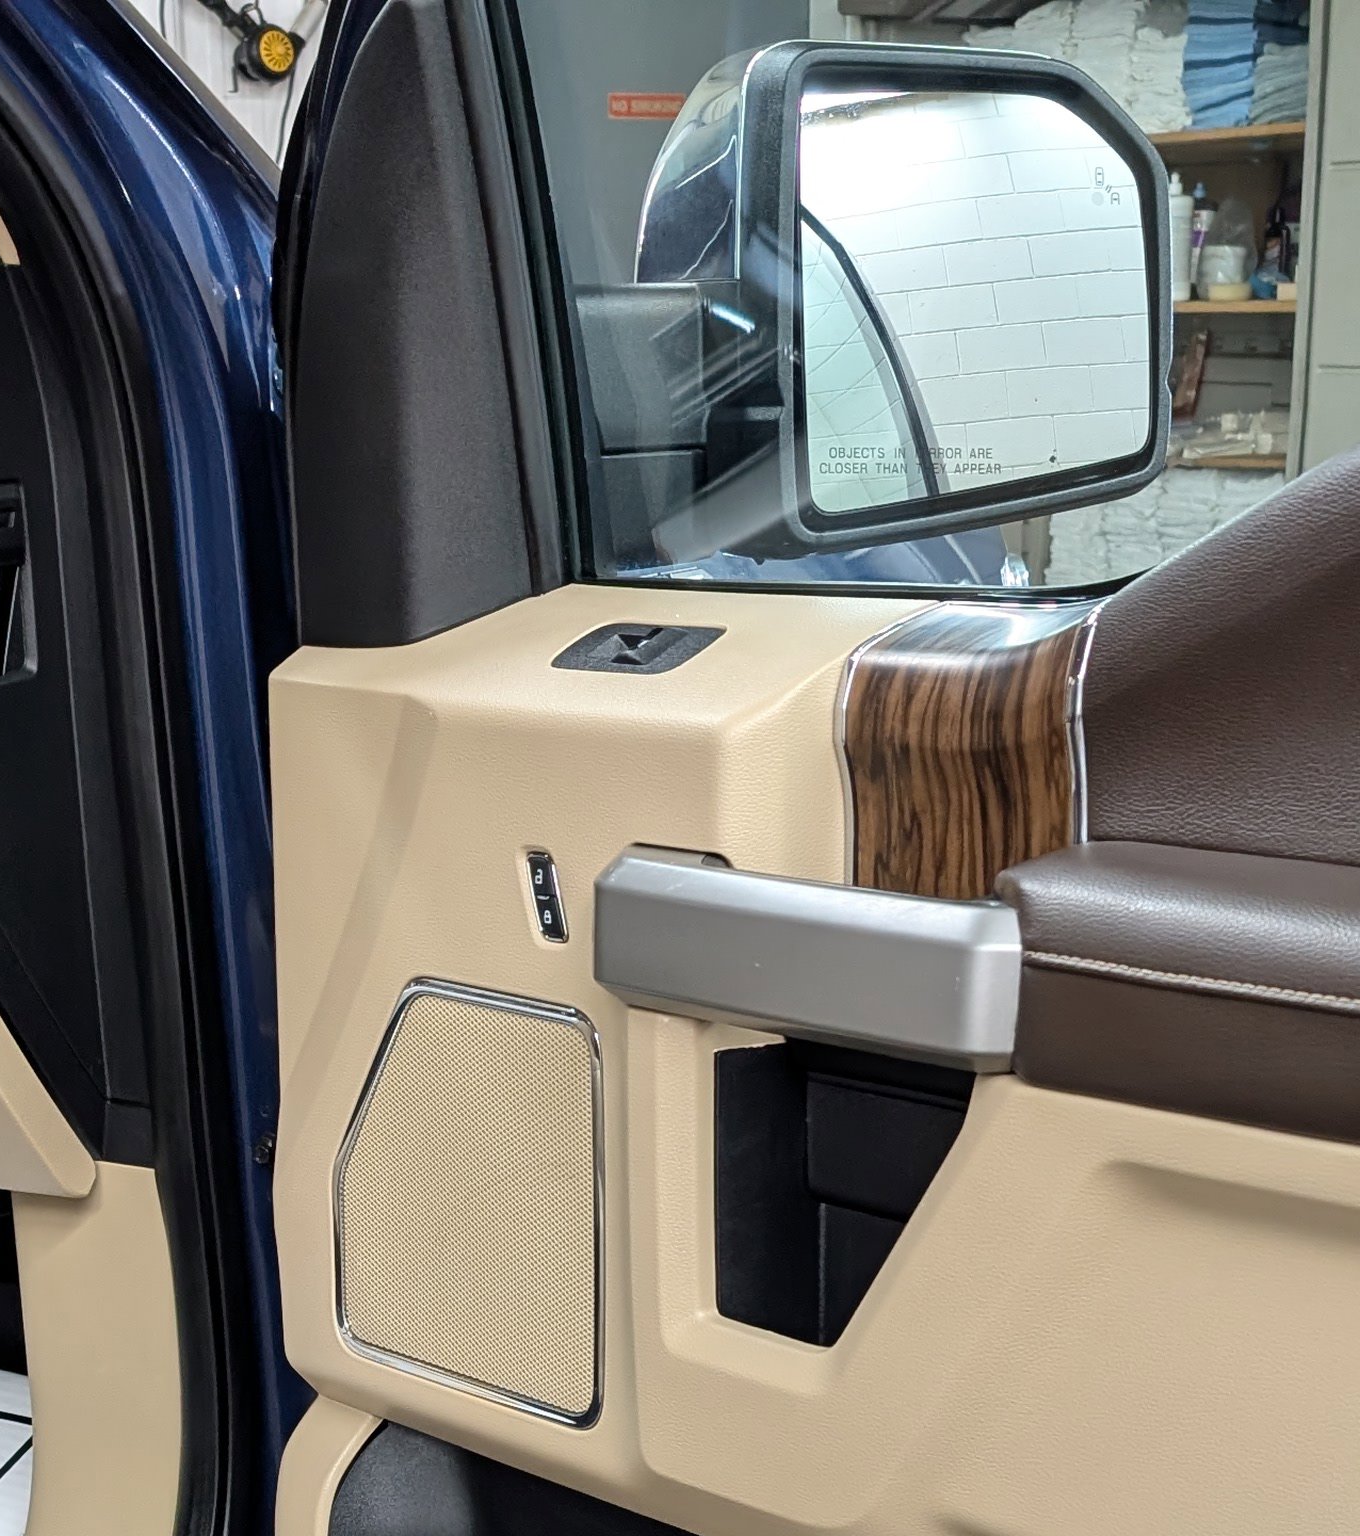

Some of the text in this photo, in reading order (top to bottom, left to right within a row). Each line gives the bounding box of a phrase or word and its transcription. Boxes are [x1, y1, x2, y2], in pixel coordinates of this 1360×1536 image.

[828, 447, 993, 459] OBJECTS IN RROR ARE
[819, 462, 1002, 474] CLOSER THAN TEY APPEAR
